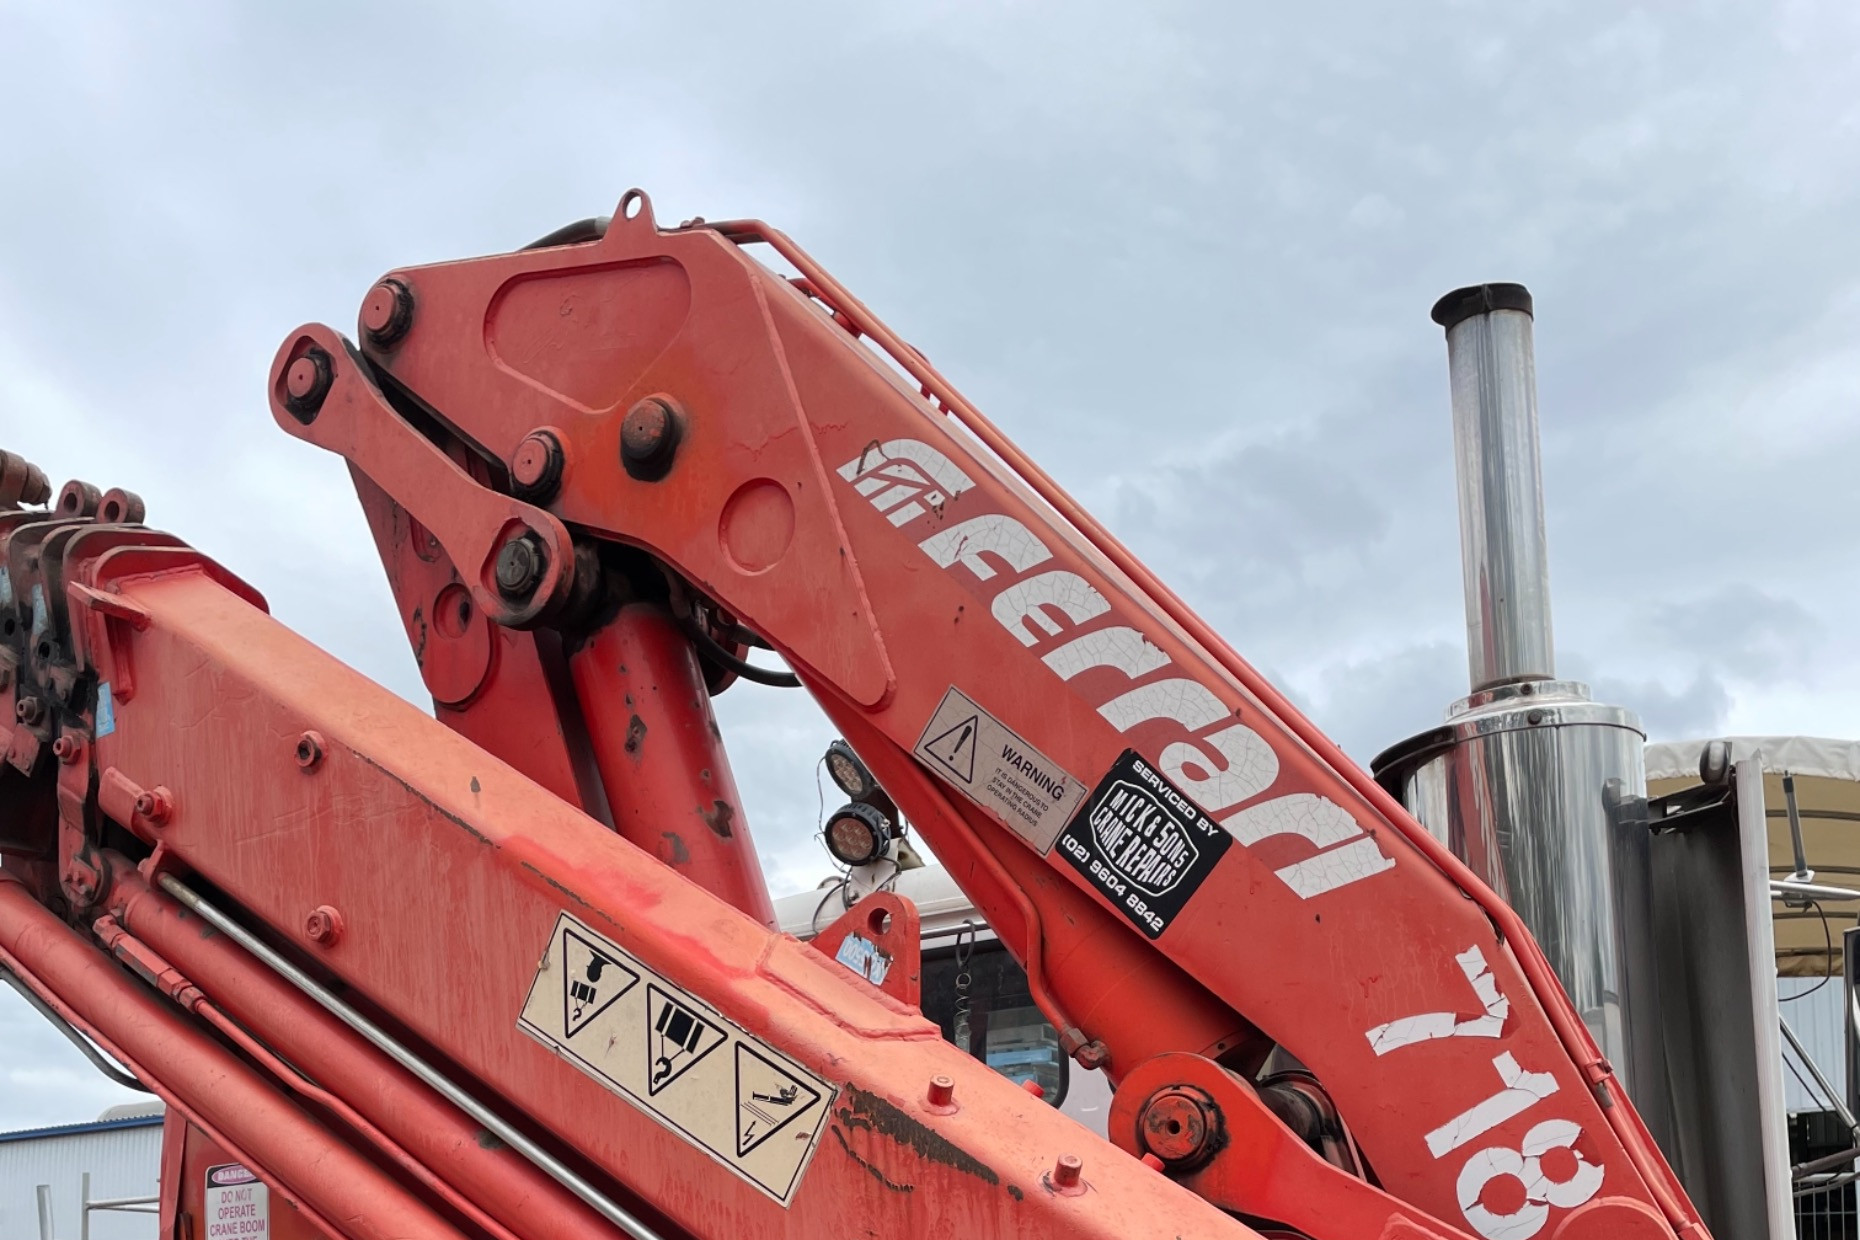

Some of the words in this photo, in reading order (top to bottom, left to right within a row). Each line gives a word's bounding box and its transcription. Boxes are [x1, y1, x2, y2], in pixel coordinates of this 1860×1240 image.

[1002, 744, 1065, 801] WARNING
[986, 784, 1017, 810] OPERATING
[1017, 807, 1038, 827] RADIUS
[992, 777, 1006, 789] STAY
[1005, 786, 1012, 795] IN
[1012, 791, 1024, 804] THE
[1023, 801, 1042, 819] CRANE
[1007, 777, 1042, 806] DANGEROUS
[1040, 801, 1049, 812] TO
[1109, 789, 1157, 833] MICK
[1132, 759, 1197, 820] SERVICED
[1196, 817, 1220, 837] BY
[1094, 807, 1133, 859] CRANE
[1115, 835, 1177, 887] REPAIRS
[1144, 815, 1162, 838] &
[1152, 821, 1189, 868] SONS
[1062, 834, 1091, 863] (02)
[1089, 860, 1127, 897] 9604
[1126, 893, 1165, 932] 8842
[217, 1169, 252, 1182] DANGE
[221, 1191, 233, 1204] DO
[235, 1188, 253, 1202] NOT
[209, 1222, 238, 1237] CRANE
[240, 1219, 265, 1234] BOOM
[218, 1204, 256, 1220] OPERATE
